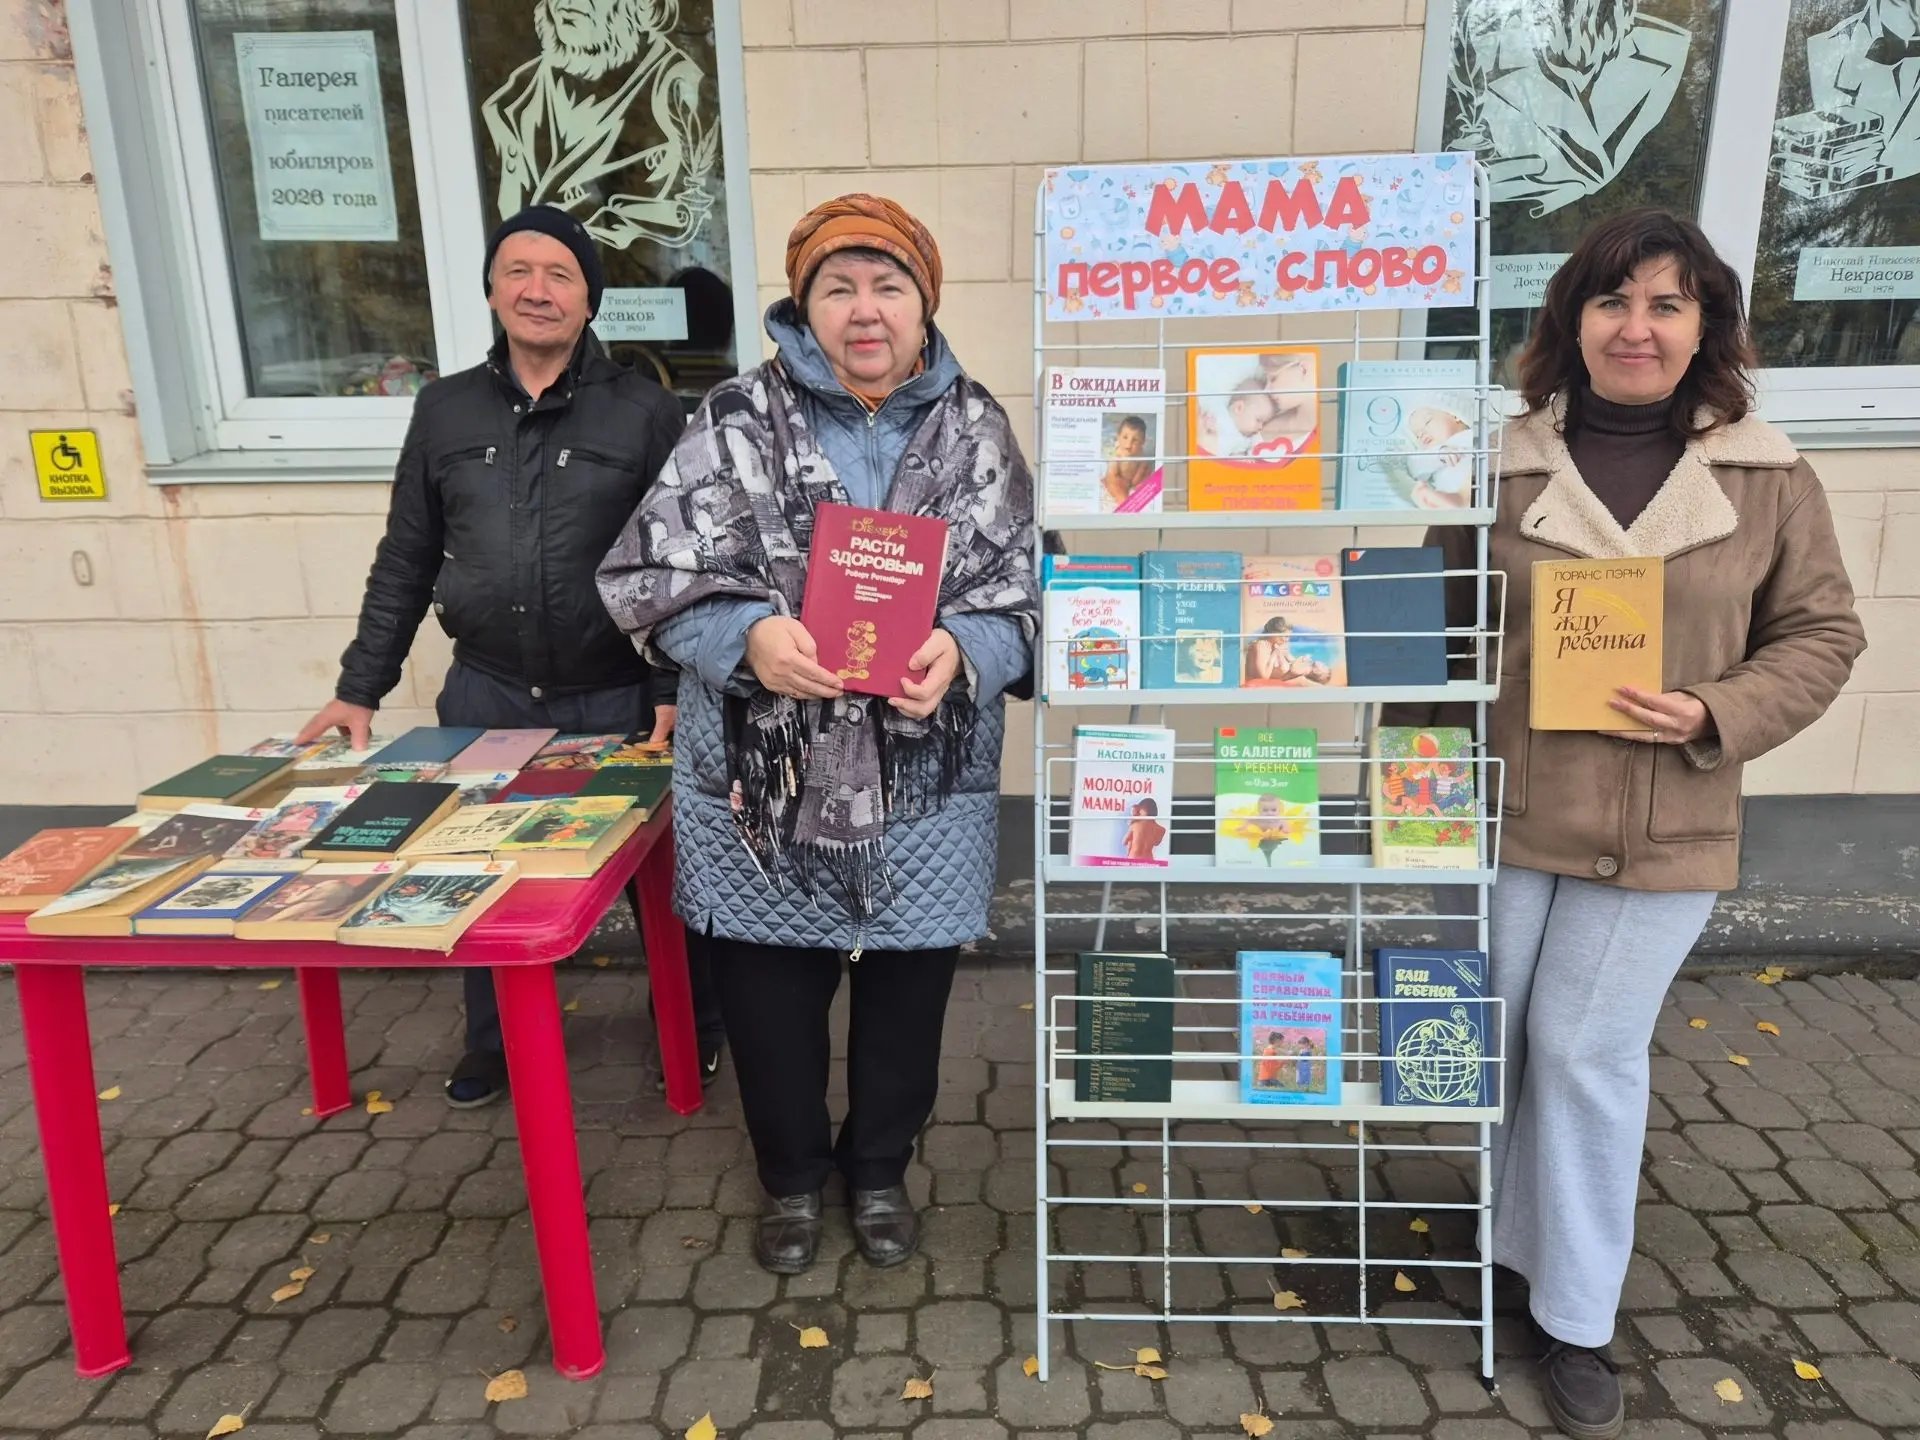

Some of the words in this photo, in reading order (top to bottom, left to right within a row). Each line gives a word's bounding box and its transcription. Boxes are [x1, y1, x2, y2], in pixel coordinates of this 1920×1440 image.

[258, 67, 359, 92] Галерея
[264, 104, 364, 125] писателей
[268, 149, 374, 174] юбиляров
[272, 188, 324, 205] 2026
[332, 192, 378, 207] года
[1145, 177, 1371, 237] МАМА
[1813, 256, 1863, 266] Николай
[1058, 257, 1240, 311] первое
[1276, 245, 1447, 292] слово
[1513, 277, 1549, 289] Досто
[1830, 267, 1914, 284] Некрасов
[1528, 291, 1544, 299] 182
[597, 311, 656, 322] ксаков
[1051, 374, 1063, 390] В
[1069, 378, 1160, 394] ОЖИДАНИИ
[1367, 396, 1401, 437] 9
[49, 474, 91, 483] КНОПКА
[49, 486, 95, 495] ВЫЗОВА
[850, 536, 905, 557] РАСТИ
[829, 549, 924, 576] ЗДОРОВЫМ
[1554, 570, 1602, 581] ЛОРАНС
[1605, 568, 1646, 579] ПЭРНУ
[1250, 583, 1330, 596] МАССАЖ
[1551, 587, 1579, 614] Я
[1553, 615, 1608, 635] жду
[1556, 633, 1646, 659] ребенка
[1097, 750, 1166, 760] НАСТОЛЬНАЯ
[1220, 745, 1238, 757] ОБ
[1242, 746, 1312, 758] АЛЛЕРГИИ
[1132, 763, 1164, 774] КНИГА
[1083, 777, 1152, 795] МОЛОДОЙ
[1082, 797, 1125, 812] МАМЫ
[1395, 968, 1430, 982] ВАШ
[1253, 984, 1332, 997] СПРАВОЧНИК
[1394, 983, 1458, 998] РЕБЕНОК
[1253, 1010, 1267, 1019] ЗА
